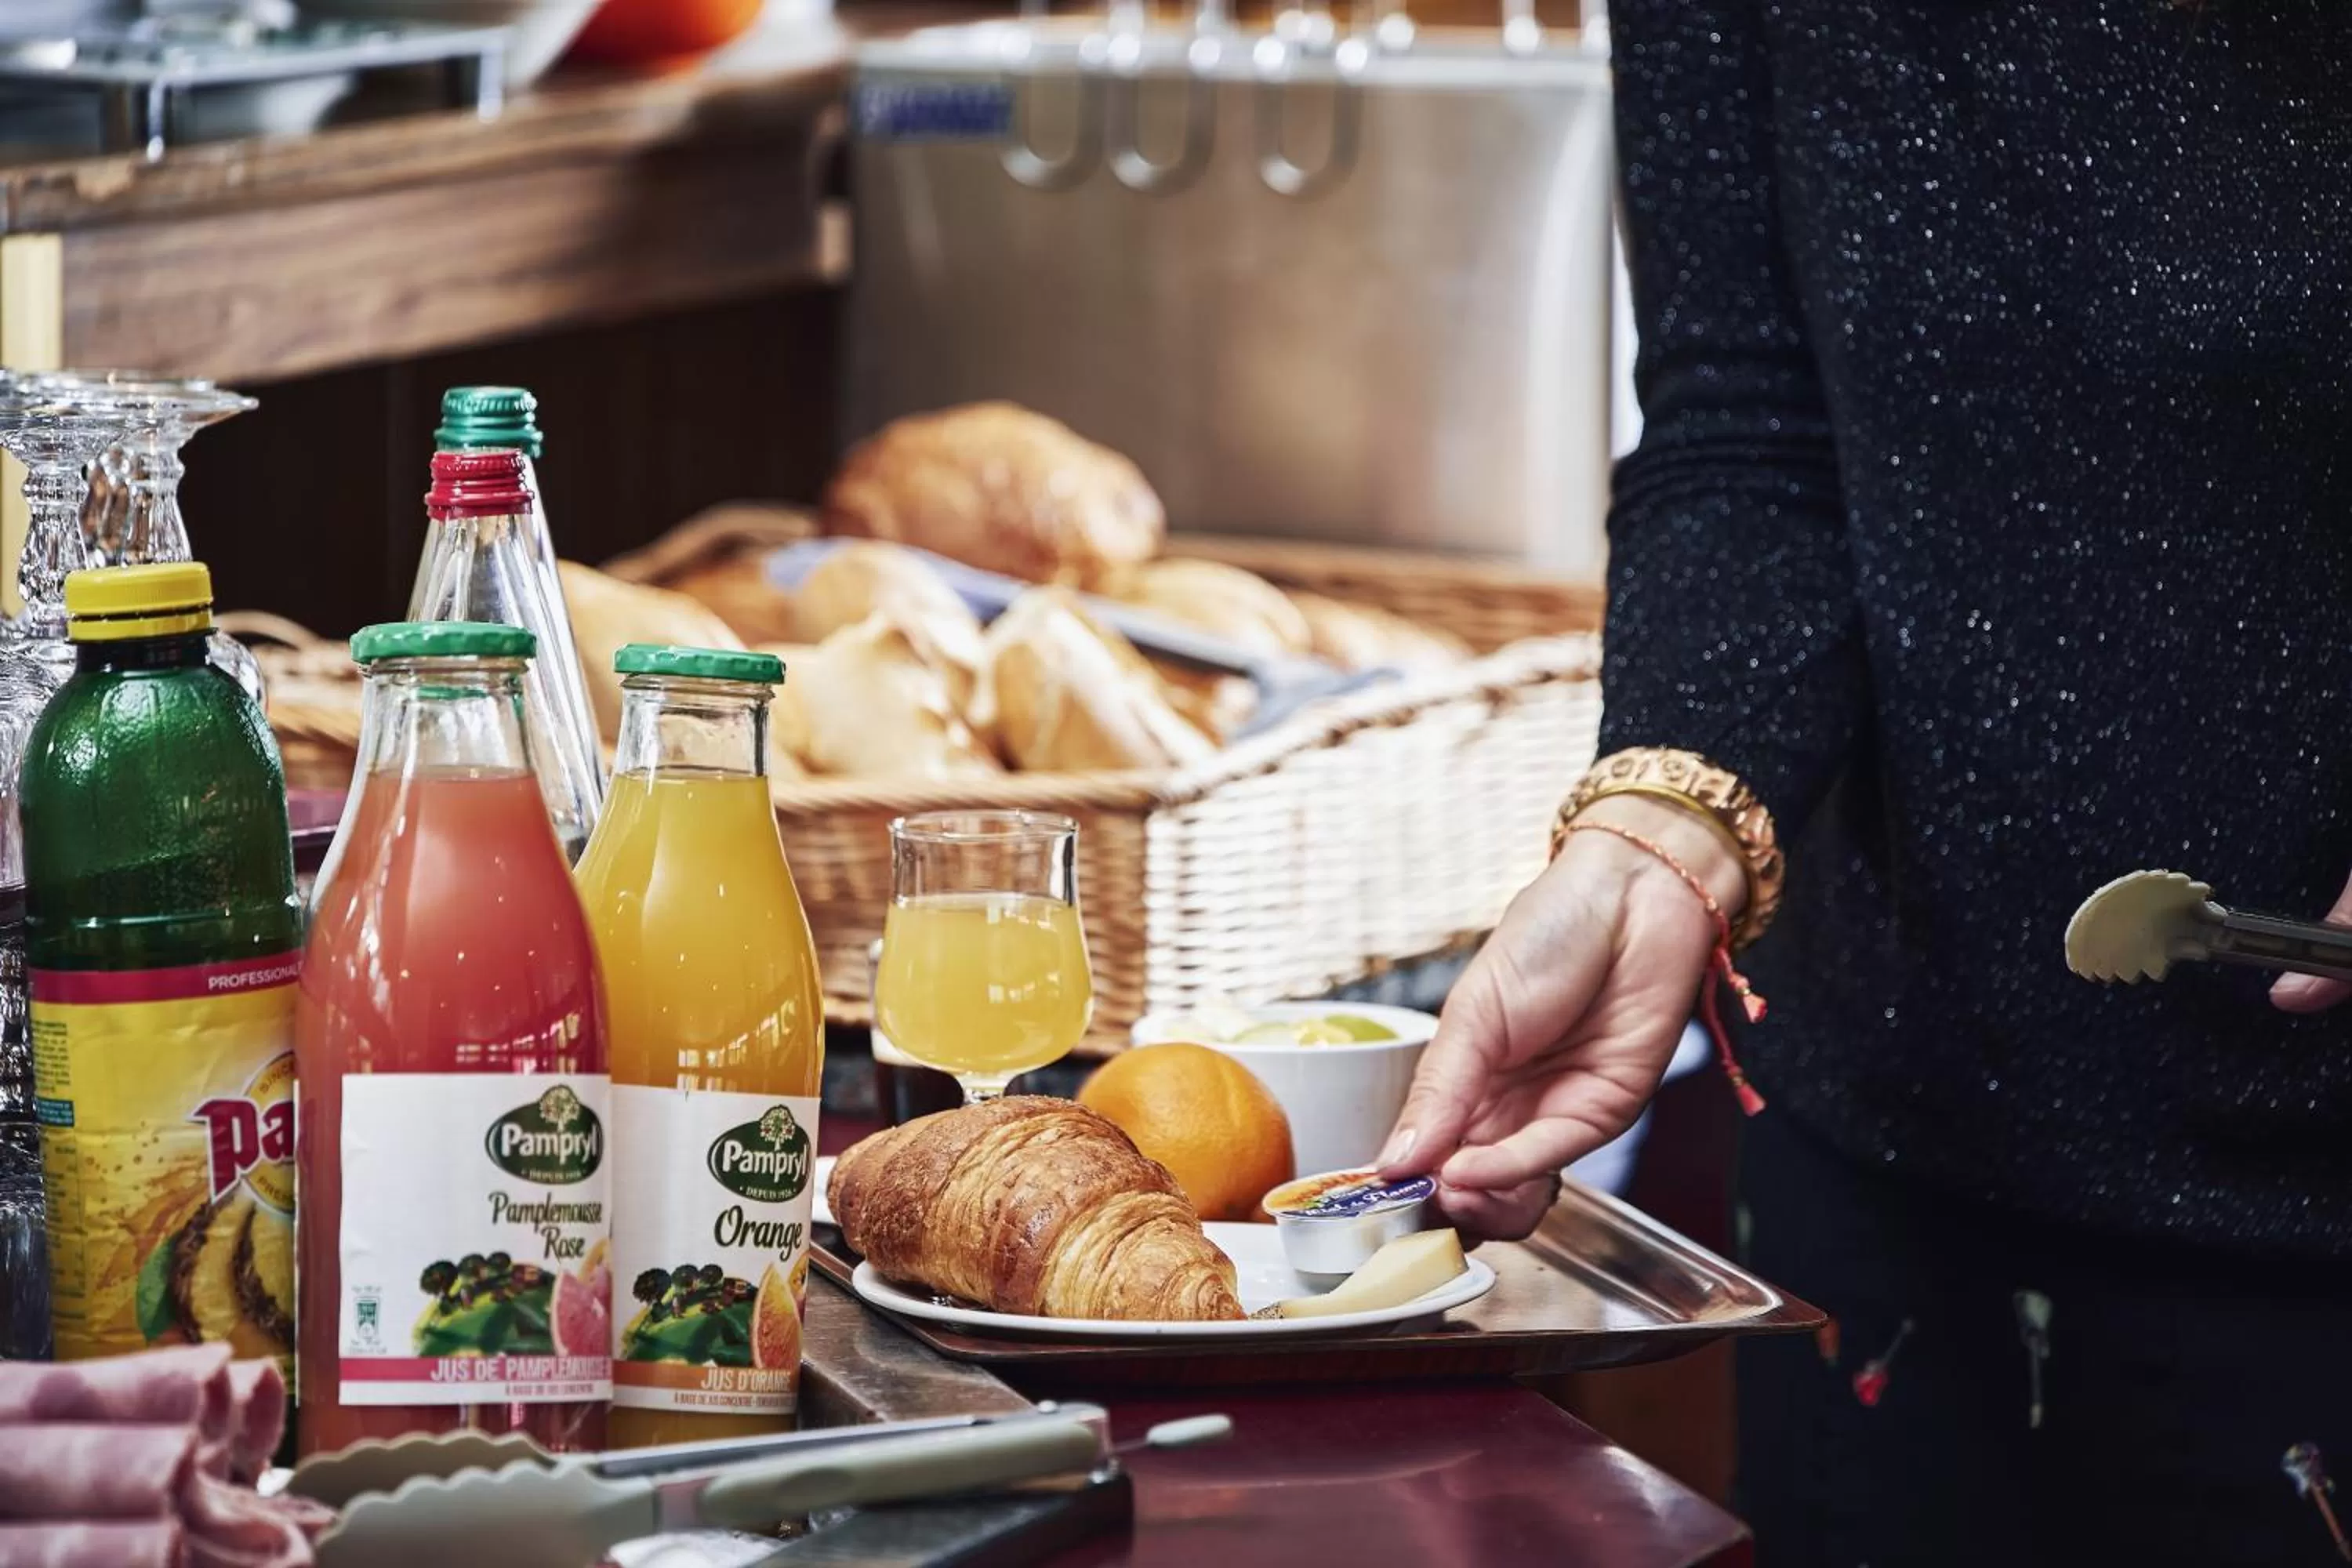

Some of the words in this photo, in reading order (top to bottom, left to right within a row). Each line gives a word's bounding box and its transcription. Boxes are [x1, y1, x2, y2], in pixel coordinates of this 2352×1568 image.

[501, 1123, 597, 1165] Pampryl
[721, 1139, 807, 1182] Pampryl
[488, 1191, 602, 1233] Pamplemousse
[714, 1205, 802, 1261] Orange
[540, 1226, 586, 1263] Rose
[430, 1359, 469, 1382] JUS
[475, 1358, 498, 1381] DE
[700, 1368, 734, 1390] JUS
